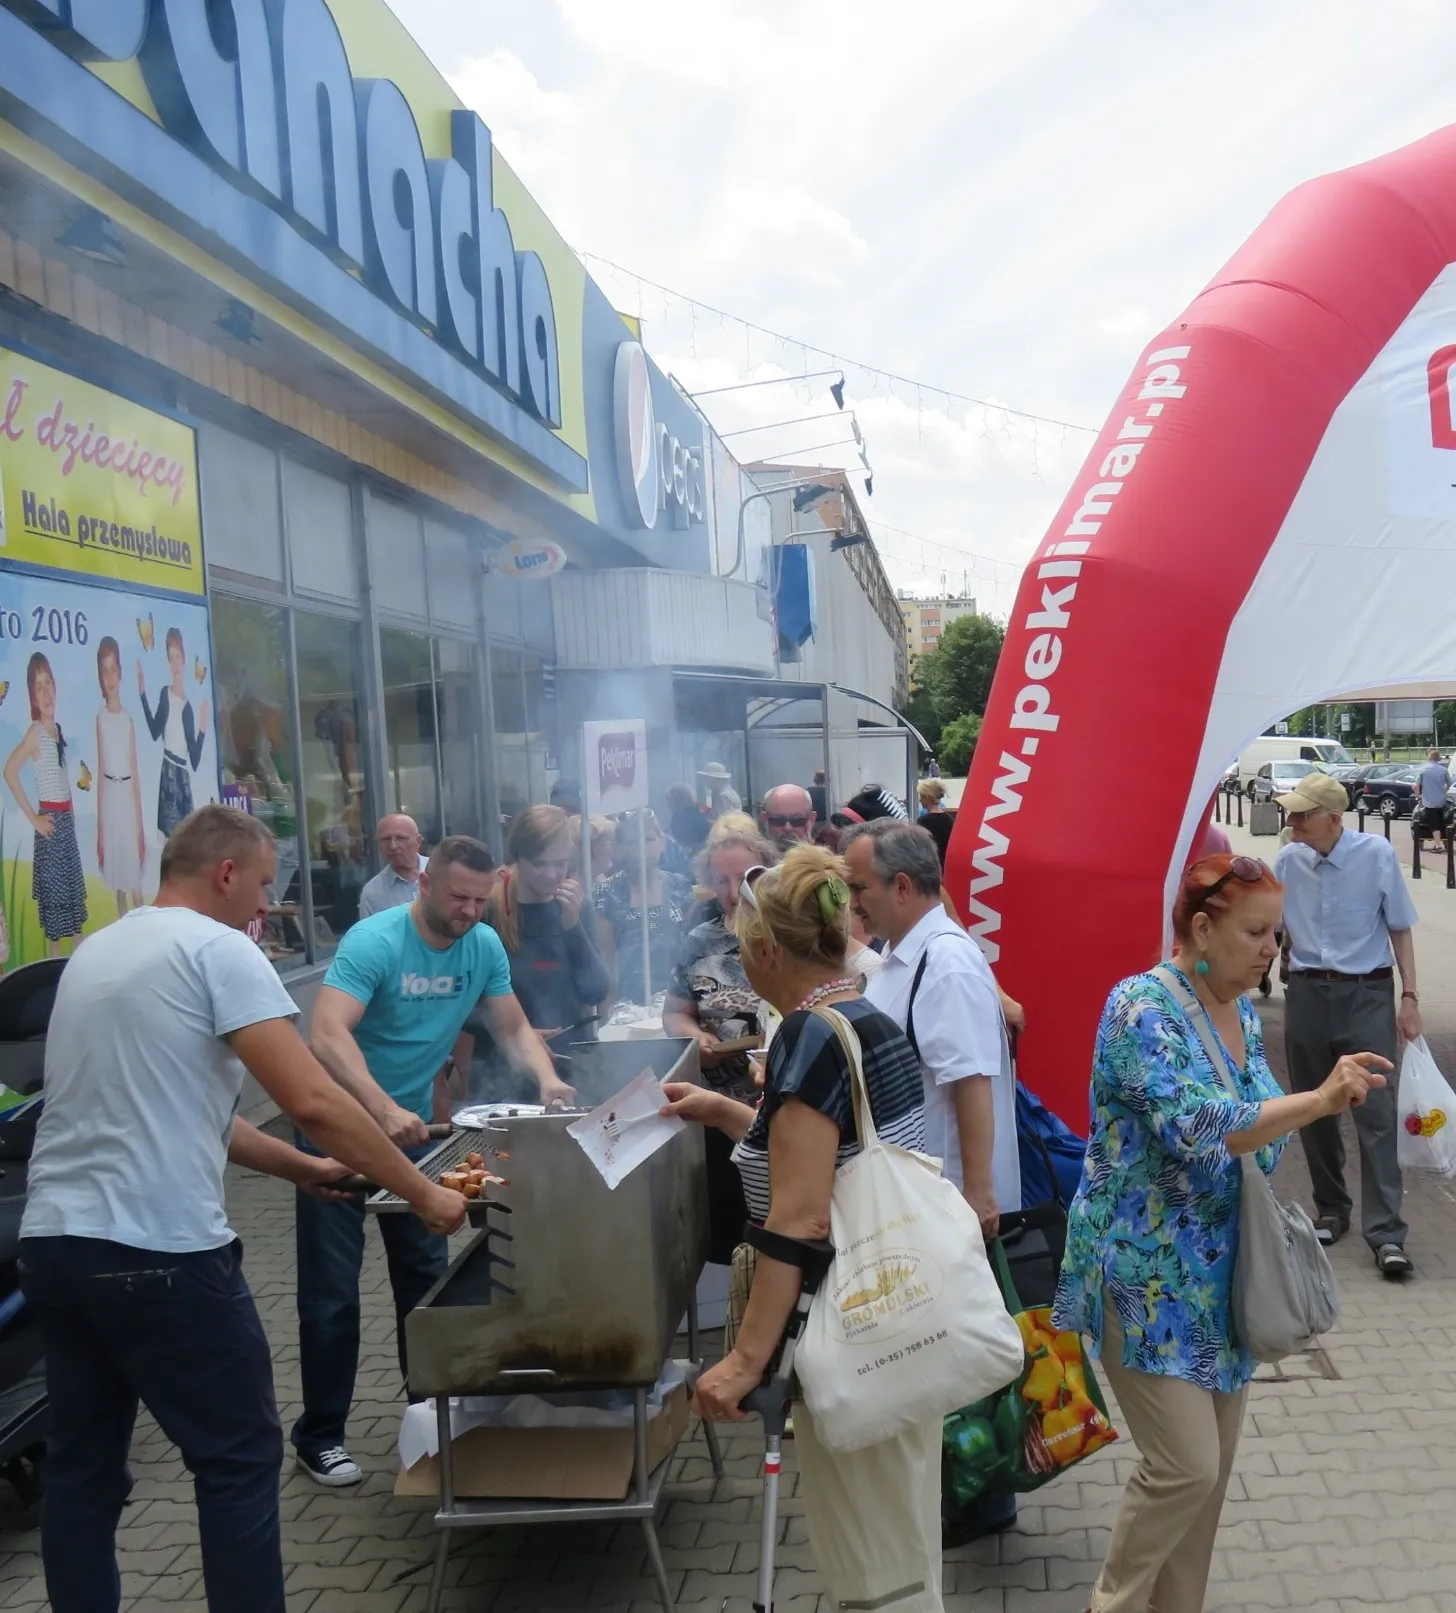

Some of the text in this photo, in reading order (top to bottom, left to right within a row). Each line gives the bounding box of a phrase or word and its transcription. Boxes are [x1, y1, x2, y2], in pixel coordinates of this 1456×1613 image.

[22, 490, 71, 537] Hala
[31, 606, 88, 645] 2016
[968, 345, 1191, 964] www.peklimar.pl
[845, 1322, 879, 1340] Piekarnia
[857, 1329, 948, 1376] tel. (0-25) 758 63 68
